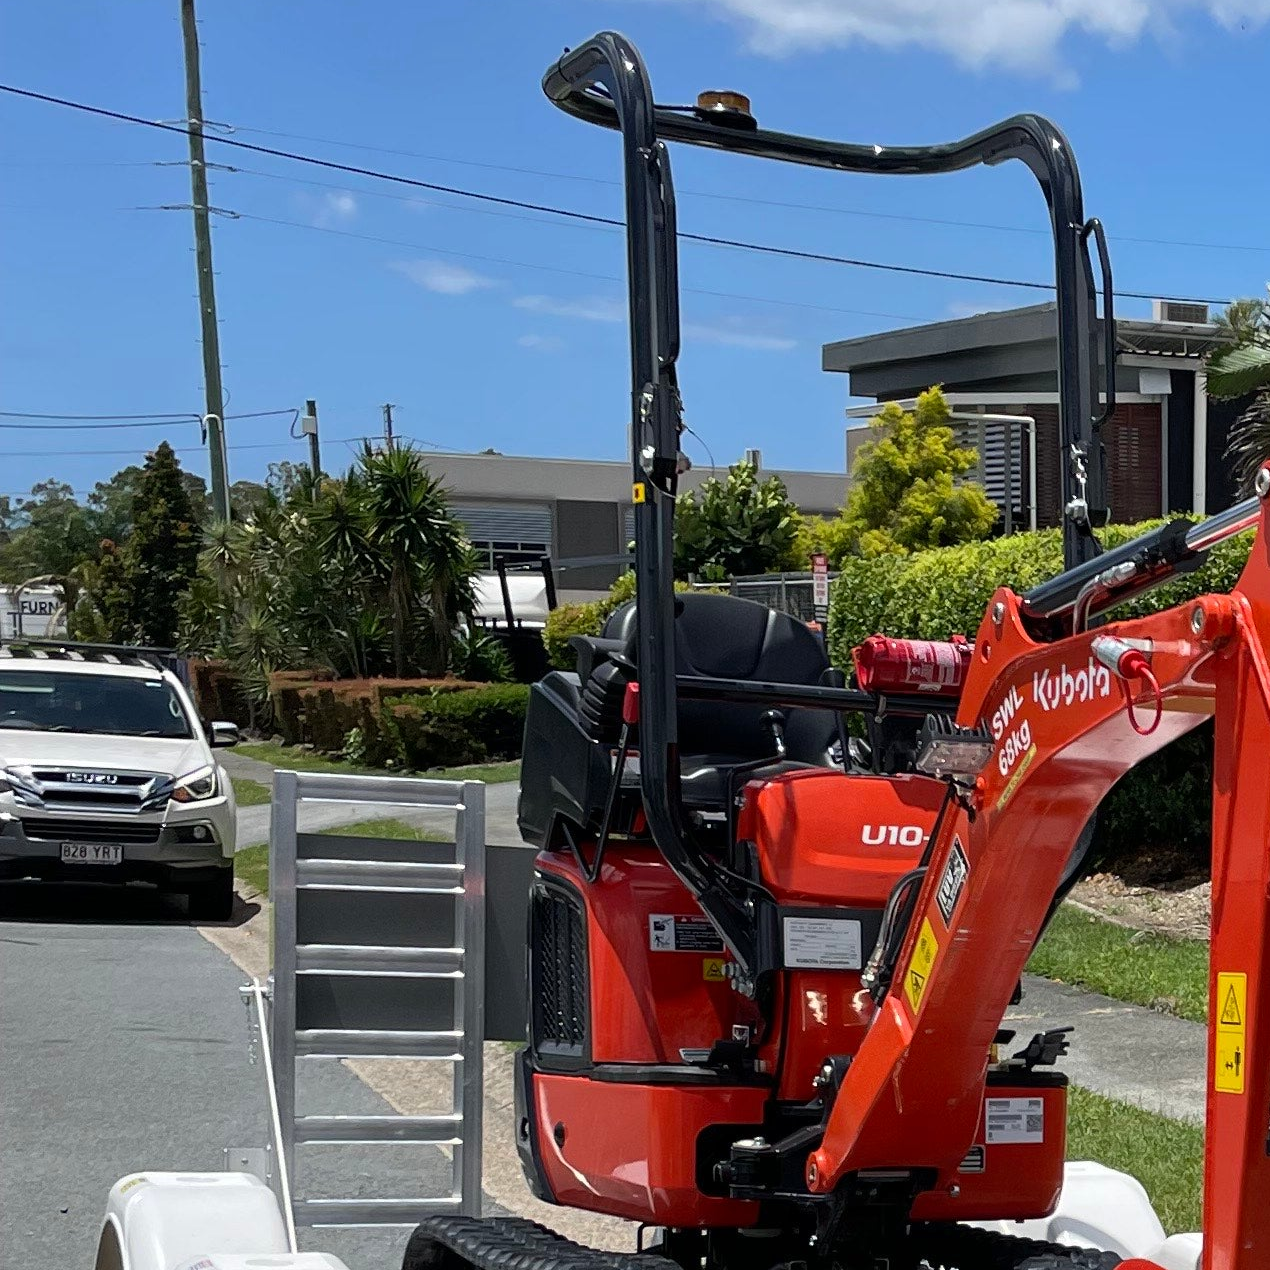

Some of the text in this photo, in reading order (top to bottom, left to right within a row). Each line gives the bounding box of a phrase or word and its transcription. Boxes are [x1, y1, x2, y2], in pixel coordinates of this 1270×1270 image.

[1033, 656, 1110, 711] Kubota
[992, 685, 1024, 741] SWL
[999, 719, 1031, 776] 68kg
[66, 772, 118, 784] ISUZU
[93, 846, 120, 859] YRT
